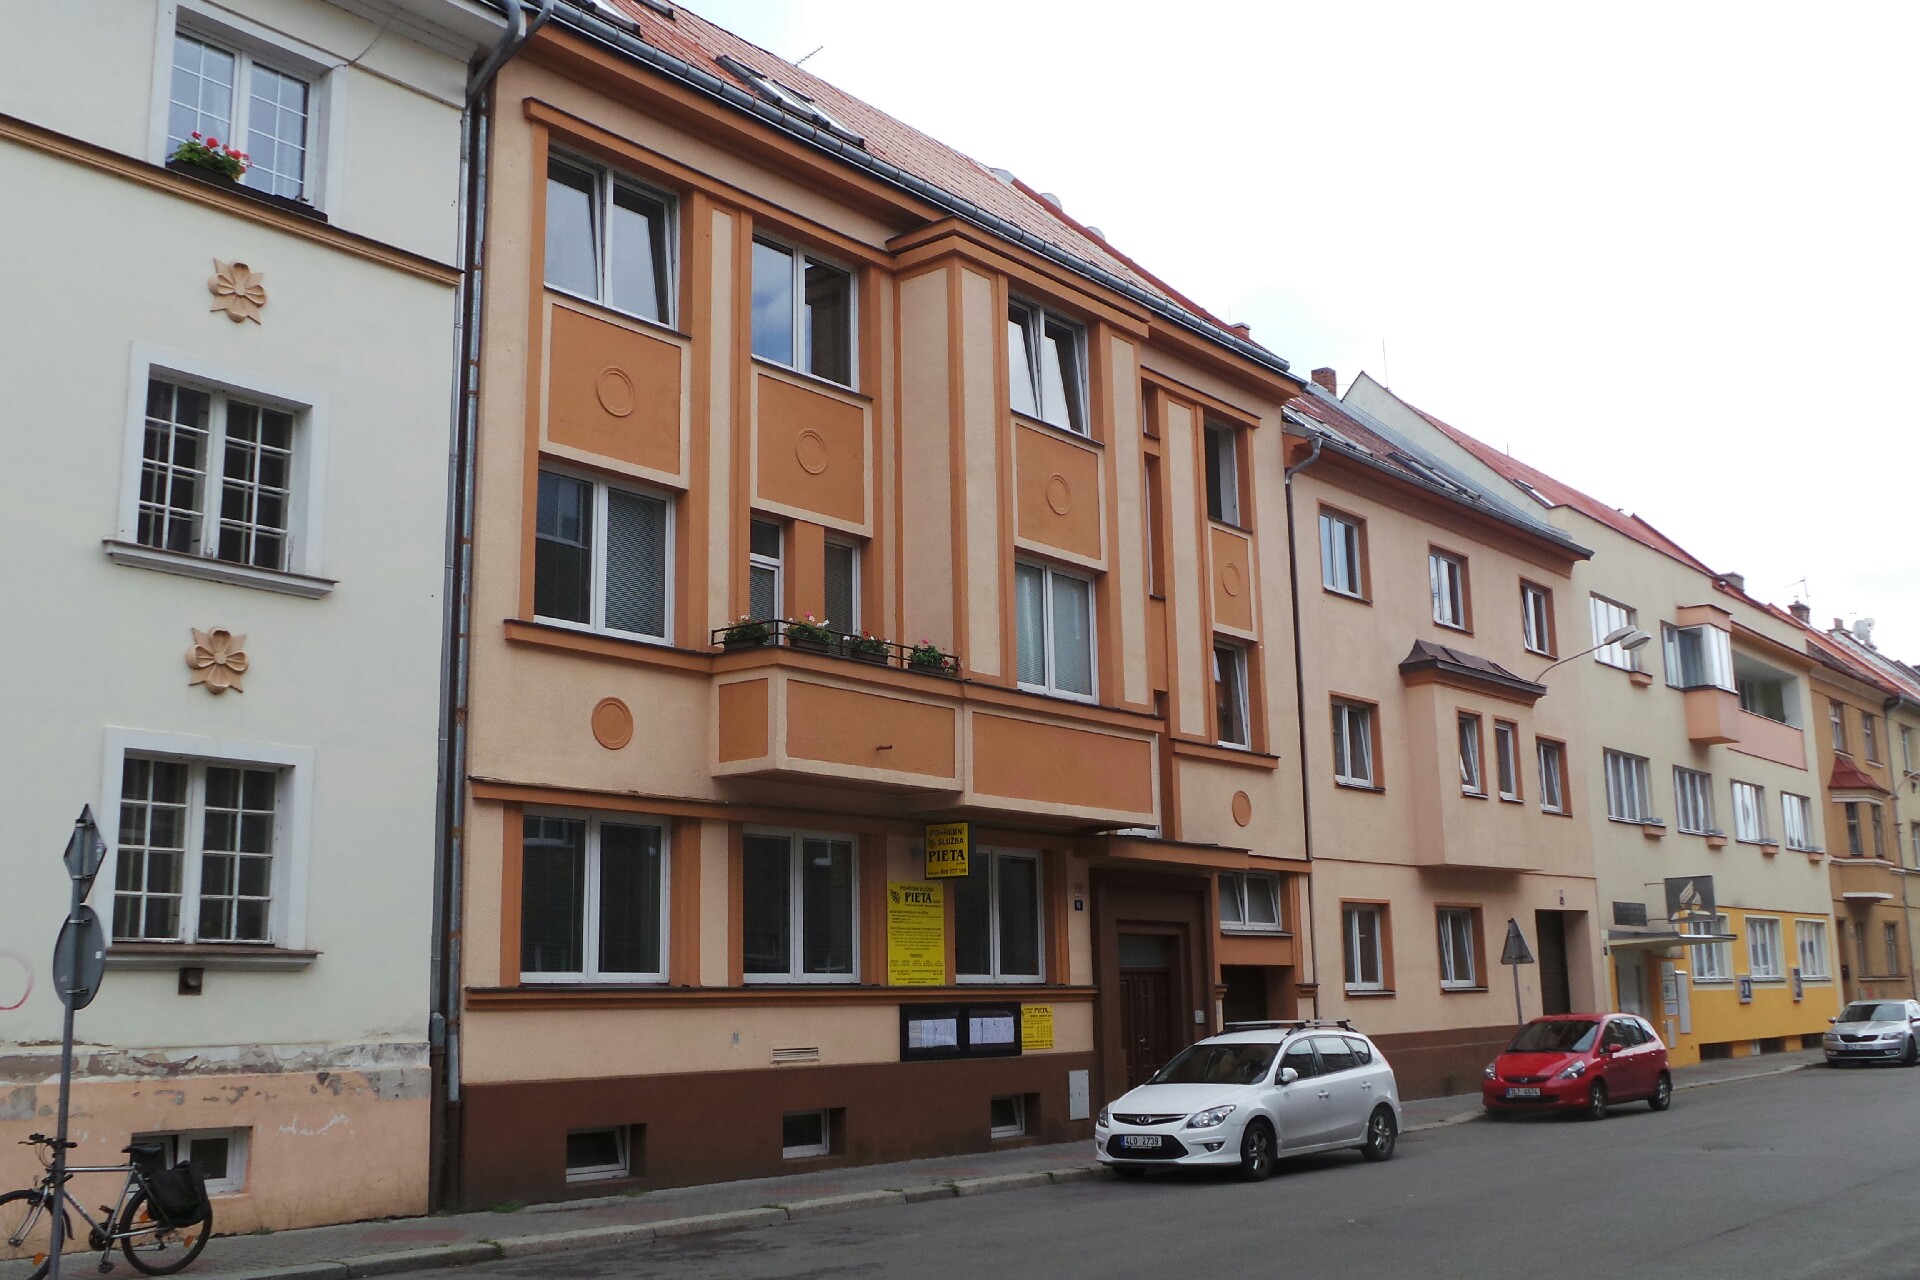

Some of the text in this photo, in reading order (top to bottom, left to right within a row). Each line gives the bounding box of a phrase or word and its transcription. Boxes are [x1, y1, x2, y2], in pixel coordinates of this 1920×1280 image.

[938, 837, 964, 846] SLUŽBA
[928, 849, 965, 862] PIETA
[905, 892, 932, 903] PIETA
[1142, 1137, 1159, 1145] 2739
